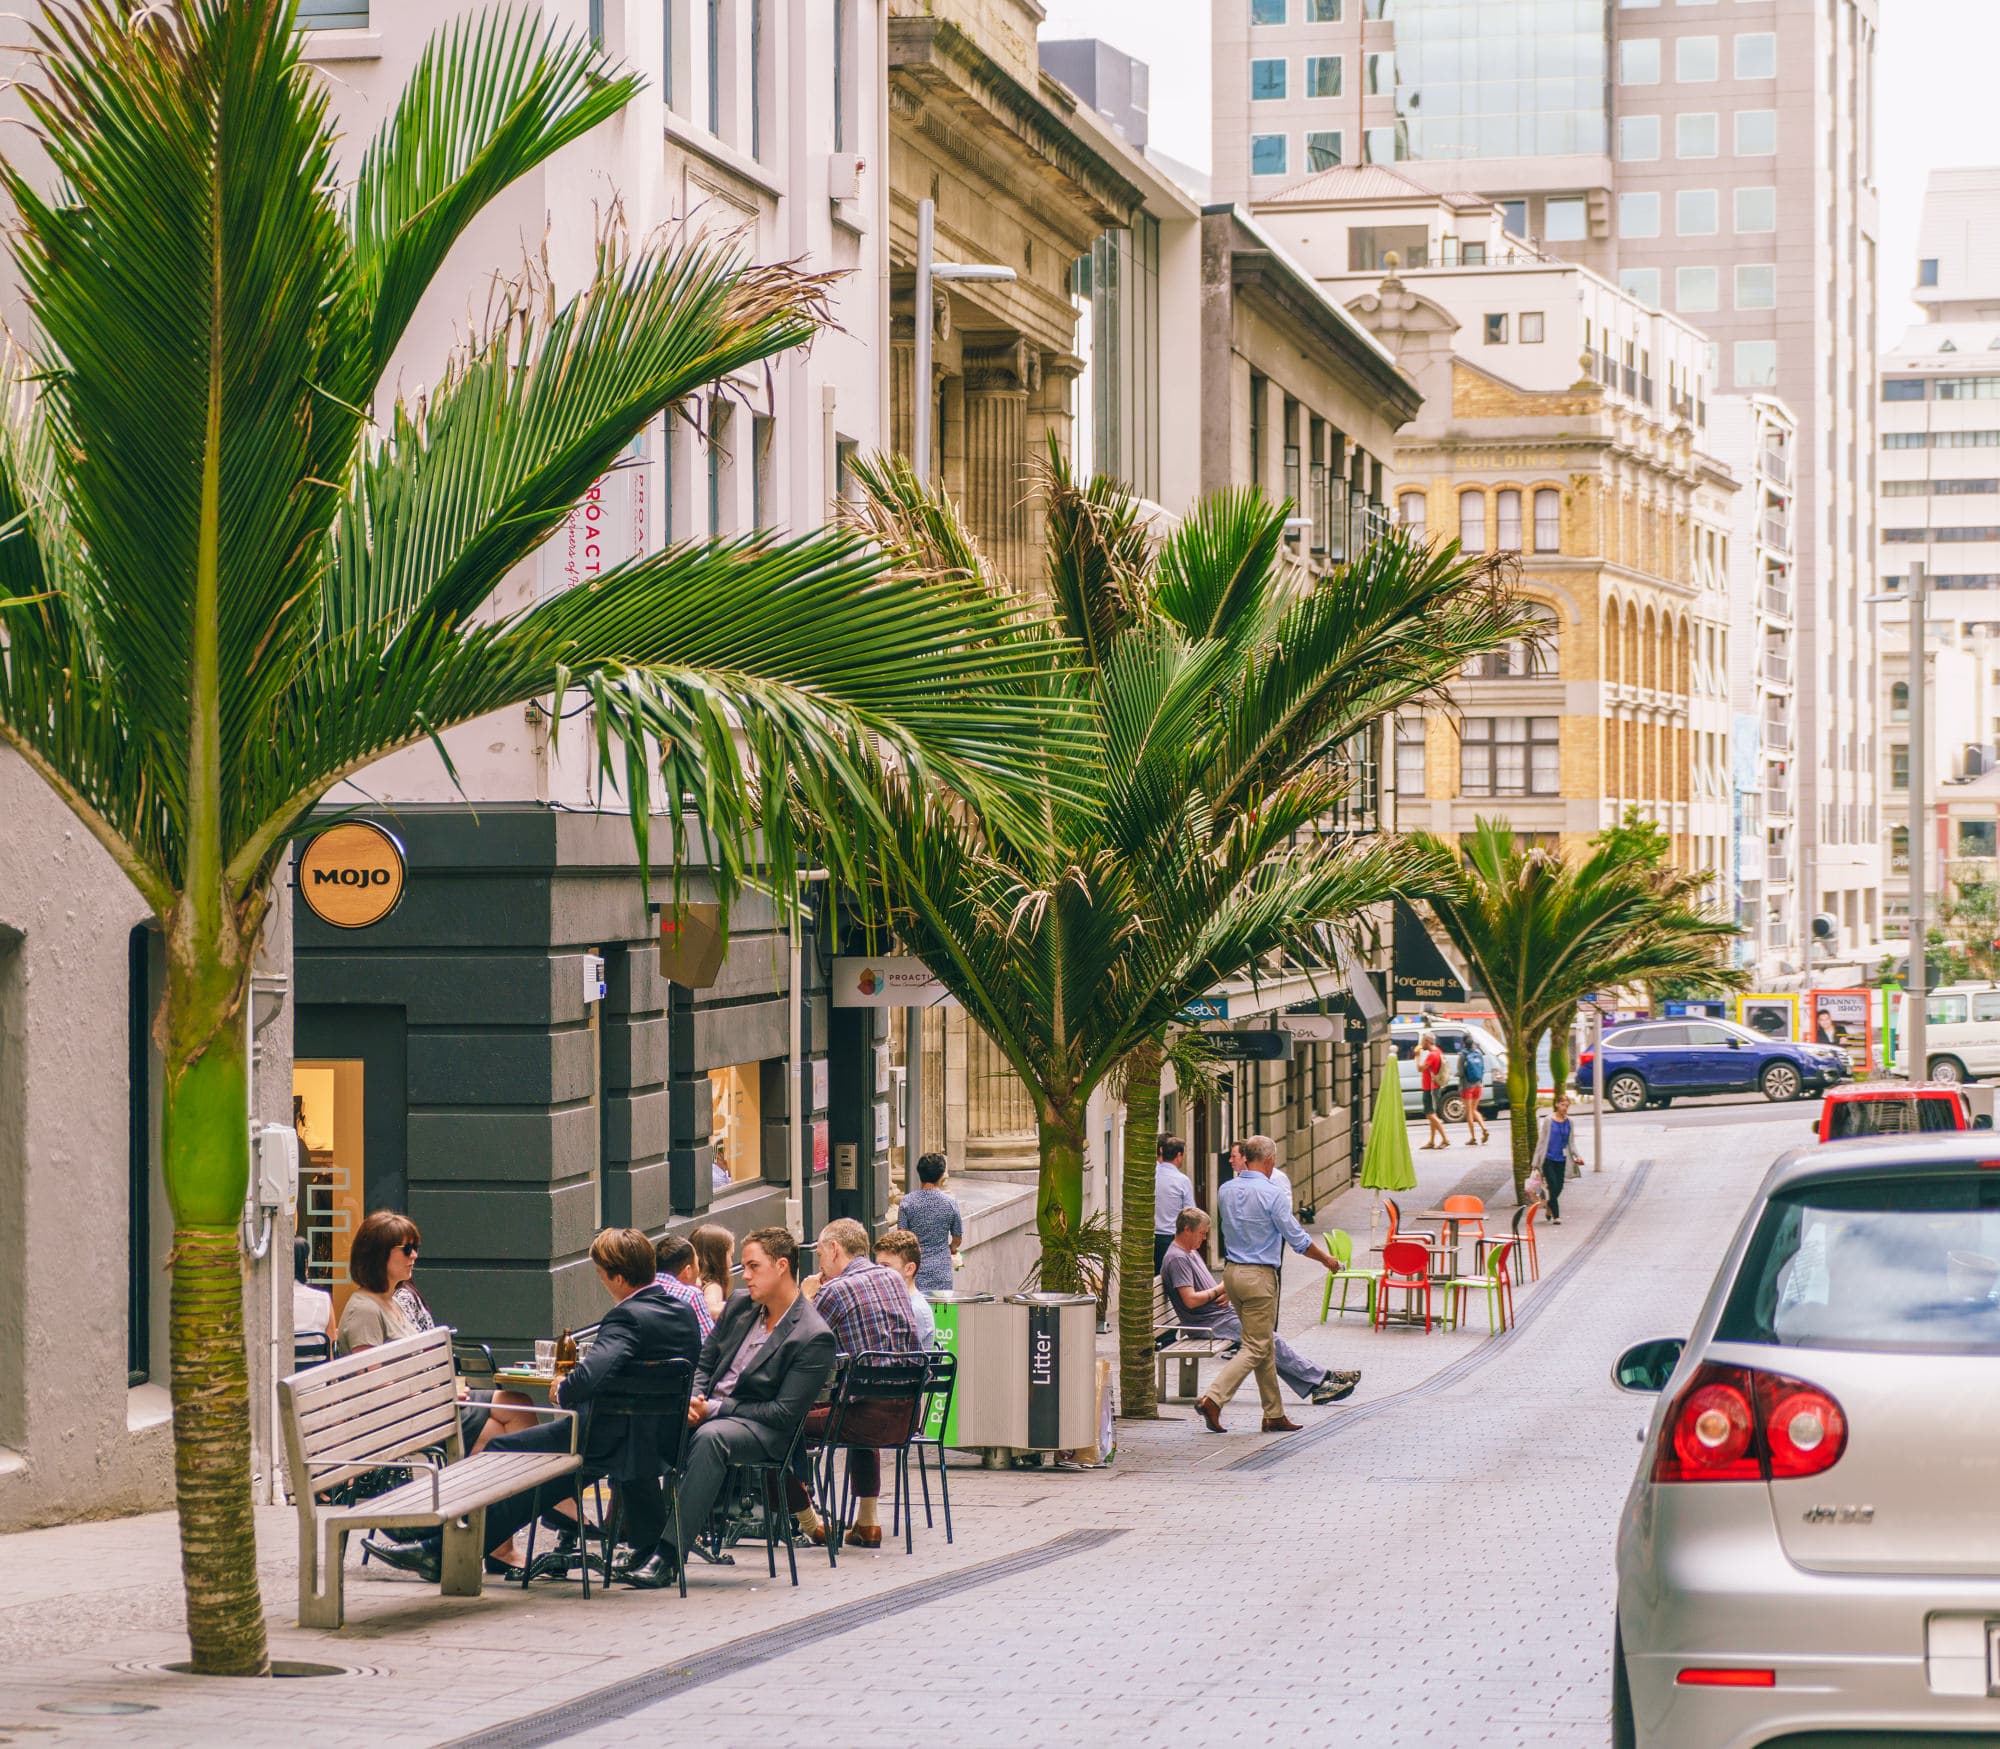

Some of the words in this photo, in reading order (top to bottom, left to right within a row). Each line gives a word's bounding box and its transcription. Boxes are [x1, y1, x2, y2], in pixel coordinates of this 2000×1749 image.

[312, 869, 390, 888] MOJO
[1399, 976, 1446, 988] O'Connell
[1415, 986, 1442, 997] Bistro
[1820, 997, 1857, 1006] DANNY
[1350, 1019, 1365, 1029] St.
[1032, 1330, 1051, 1385] Litter
